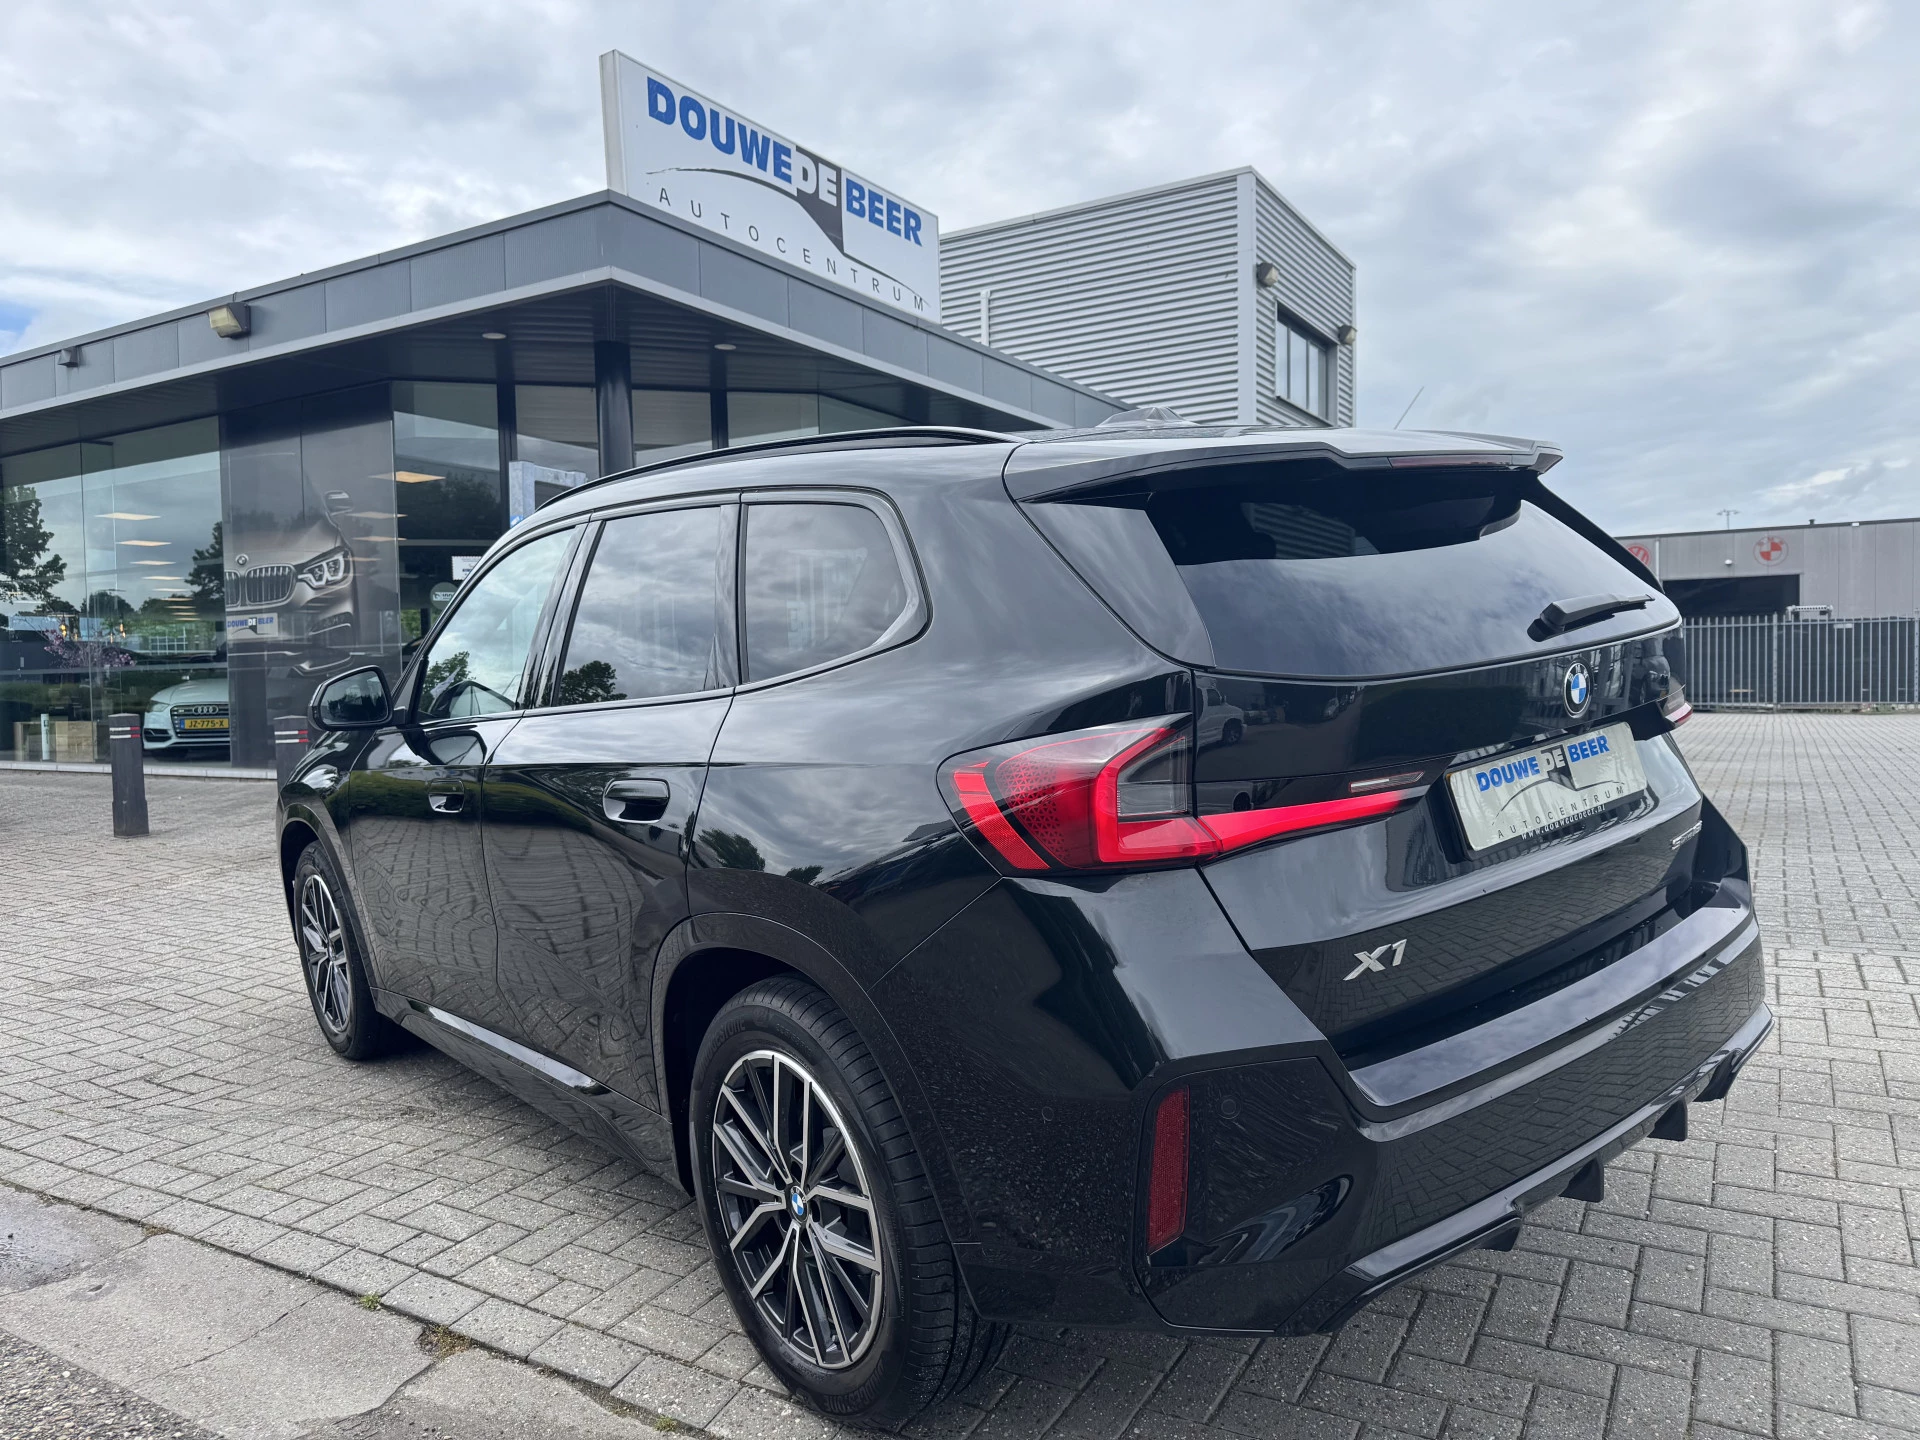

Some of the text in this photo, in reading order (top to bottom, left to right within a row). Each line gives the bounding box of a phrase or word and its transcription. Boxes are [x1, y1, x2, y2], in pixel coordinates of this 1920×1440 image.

[646, 76, 923, 247] DOUWE DE BEER
[658, 187, 925, 313] AUTOCENTRUM
[1475, 734, 1611, 793] DOUWE DE BEER
[1497, 786, 1625, 839] AUTOCENTRUM
[1343, 938, 1408, 981] X1
